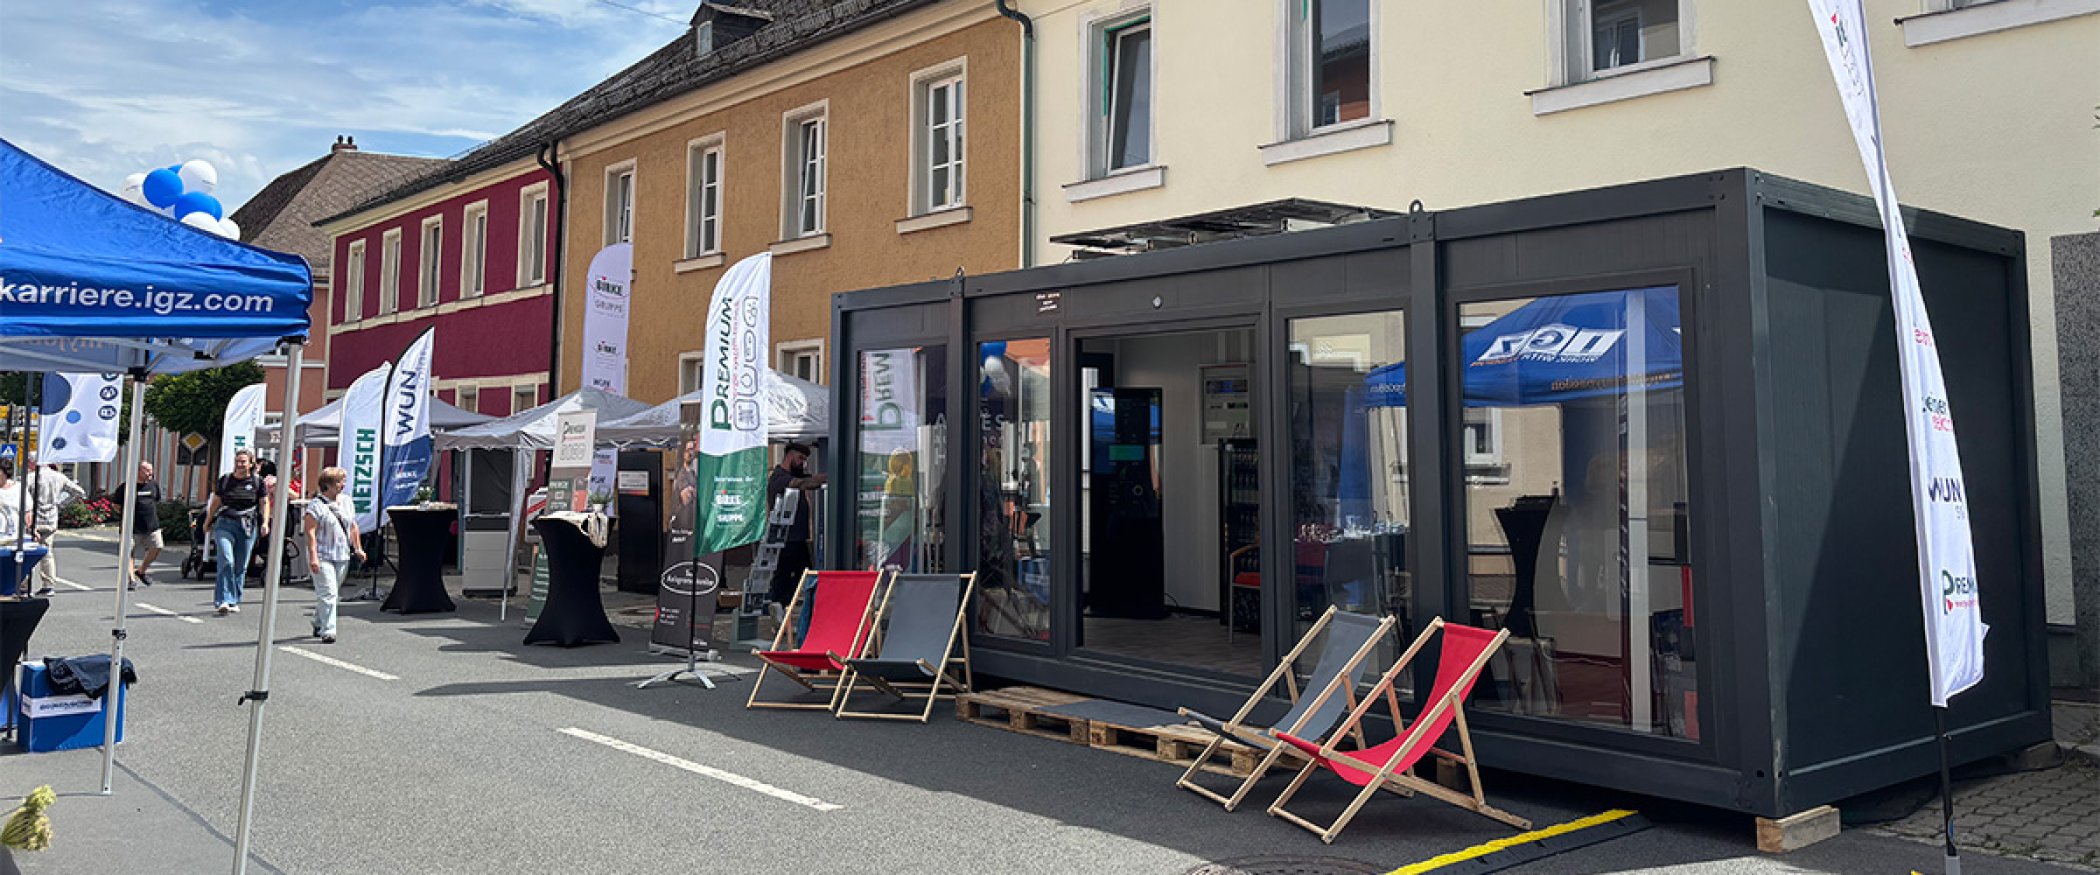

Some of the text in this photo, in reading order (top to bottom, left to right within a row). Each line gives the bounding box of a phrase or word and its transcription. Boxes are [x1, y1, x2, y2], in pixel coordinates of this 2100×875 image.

[0, 277, 273, 315] karriere.igz.com
[710, 296, 732, 431] PREMIUM
[397, 370, 416, 436] WUN
[353, 428, 376, 513] NETZSCH
